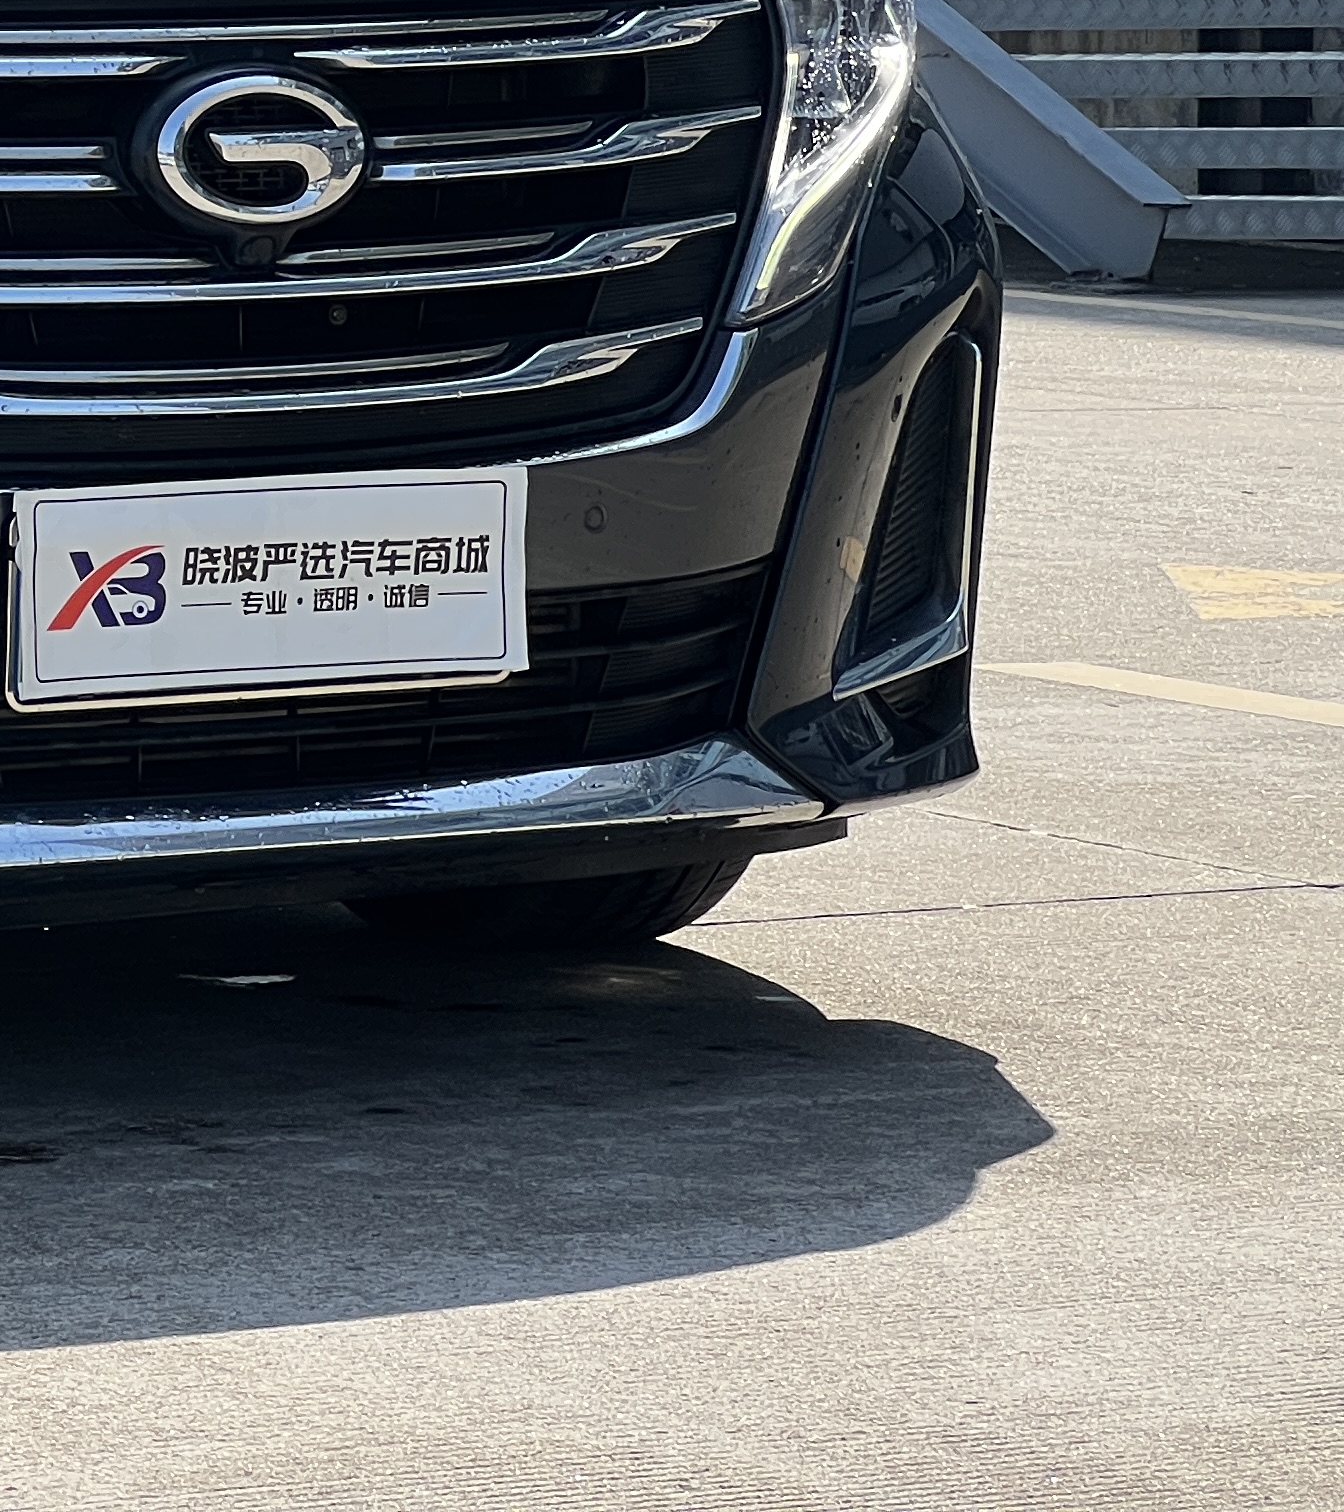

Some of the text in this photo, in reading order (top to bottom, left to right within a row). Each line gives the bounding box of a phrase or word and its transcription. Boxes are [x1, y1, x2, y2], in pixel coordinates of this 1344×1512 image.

[182, 534, 490, 586] 晓波严选汽车商城
